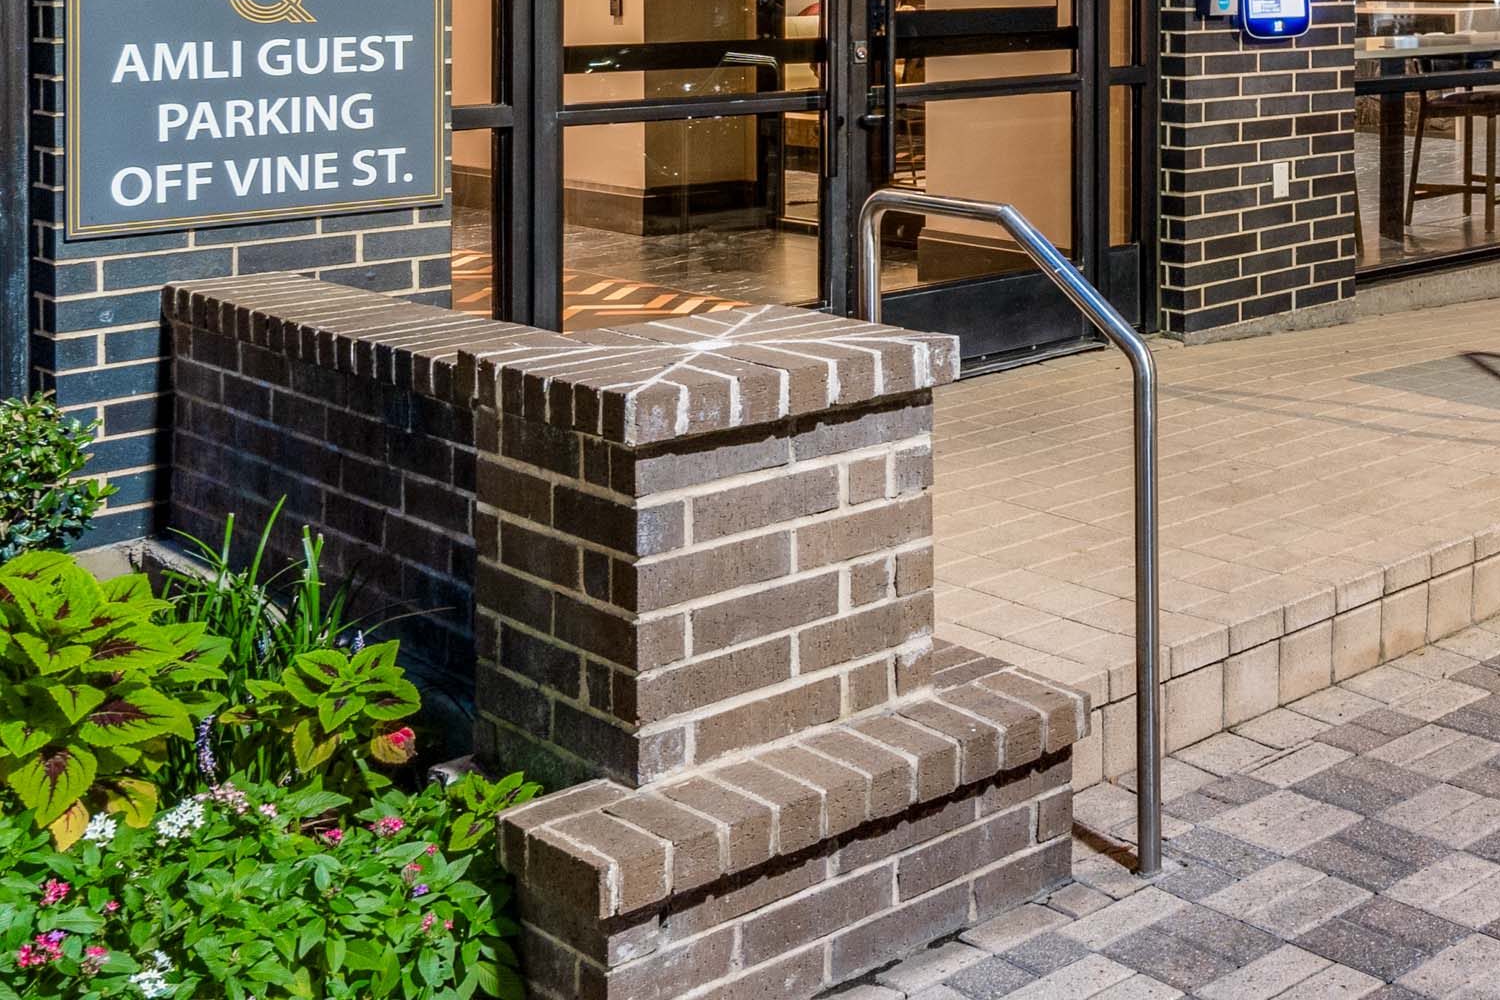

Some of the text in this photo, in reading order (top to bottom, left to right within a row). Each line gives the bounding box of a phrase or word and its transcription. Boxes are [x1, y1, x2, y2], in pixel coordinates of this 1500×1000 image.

[111, 34, 414, 84] AMLI GUEST
[158, 92, 375, 142] PARKING
[111, 147, 414, 207] OFF VINE ST.
